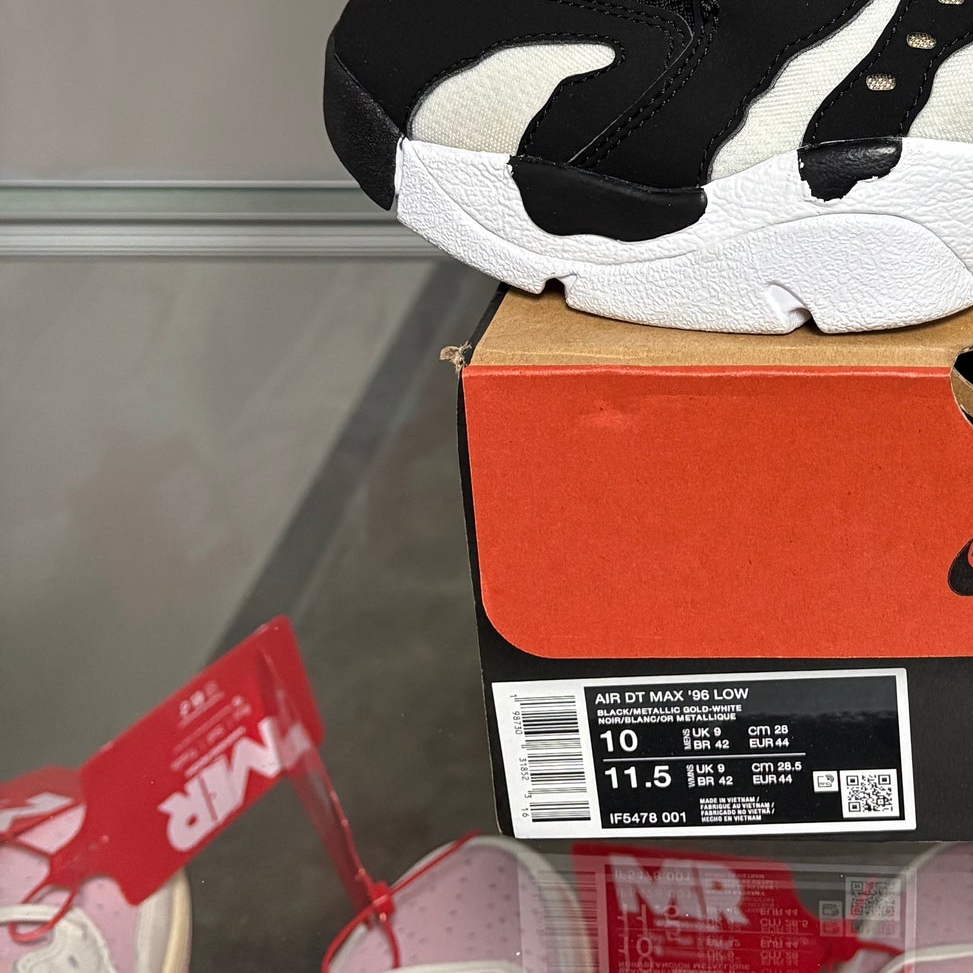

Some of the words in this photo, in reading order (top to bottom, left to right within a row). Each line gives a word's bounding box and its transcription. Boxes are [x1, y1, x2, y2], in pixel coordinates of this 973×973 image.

[595, 692, 621, 704] AIR
[625, 691, 645, 703] DT
[650, 690, 684, 702] MAX
[688, 689, 709, 701] '96
[714, 688, 749, 699] LOW
[597, 706, 680, 716] BLACK/METALLIC
[683, 704, 742, 713] GOLD-WHITE
[598, 715, 674, 724] NOIR/BLANC/OR
[677, 713, 736, 722] METALLIQUE
[692, 728, 710, 738] UK
[713, 727, 722, 736] 9
[774, 725, 789, 734] 28
[512, 711, 523, 735] 98730
[519, 757, 530, 781] 31852
[600, 729, 638, 752] 10
[682, 729, 692, 750] MENS
[693, 740, 711, 750] BR
[715, 739, 730, 749] 42
[749, 738, 774, 748] EUR
[775, 738, 790, 747] 44
[696, 764, 714, 774] UK
[717, 764, 725, 773] 9
[777, 762, 802, 771] 28.5
[604, 765, 672, 789] 11.5
[686, 764, 696, 788] WMNS
[697, 777, 715, 786] BR
[719, 776, 734, 786] 42
[752, 775, 777, 785] EUR
[778, 774, 793, 784] 44
[609, 812, 658, 824] IF5478
[661, 811, 686, 823] 001
